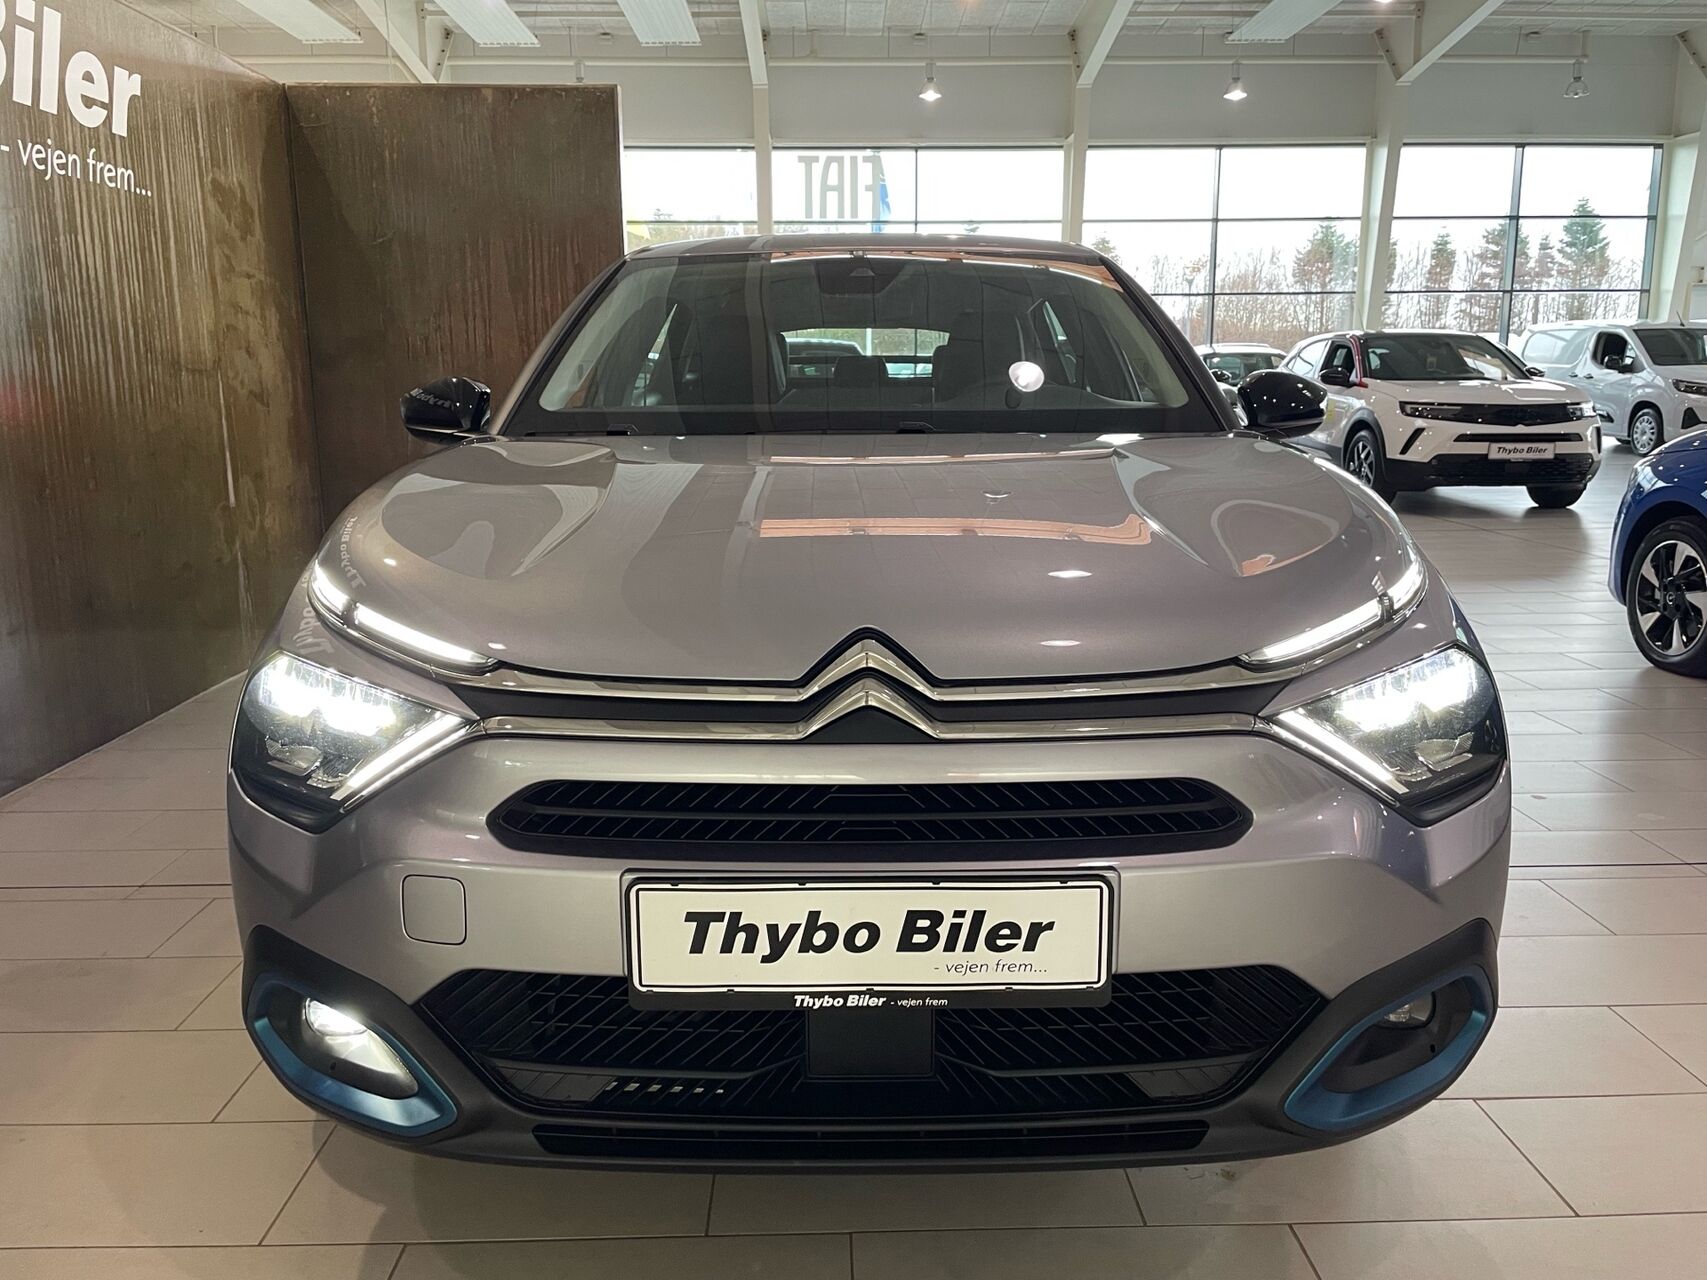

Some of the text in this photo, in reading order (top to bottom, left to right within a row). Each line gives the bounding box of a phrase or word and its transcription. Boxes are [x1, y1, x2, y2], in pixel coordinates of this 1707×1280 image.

[0, 0, 141, 137] iler
[18, 138, 81, 181] vejen
[86, 147, 152, 197] frem...
[1496, 446, 1548, 455] Thybo Biler
[684, 909, 1055, 964] Thybo Biler
[945, 960, 989, 976] vejen
[995, 959, 1047, 973] frem...
[793, 994, 844, 1009] Thybo
[846, 994, 887, 1007] Biler
[897, 998, 923, 1008] vejen
[925, 997, 948, 1006] frem
